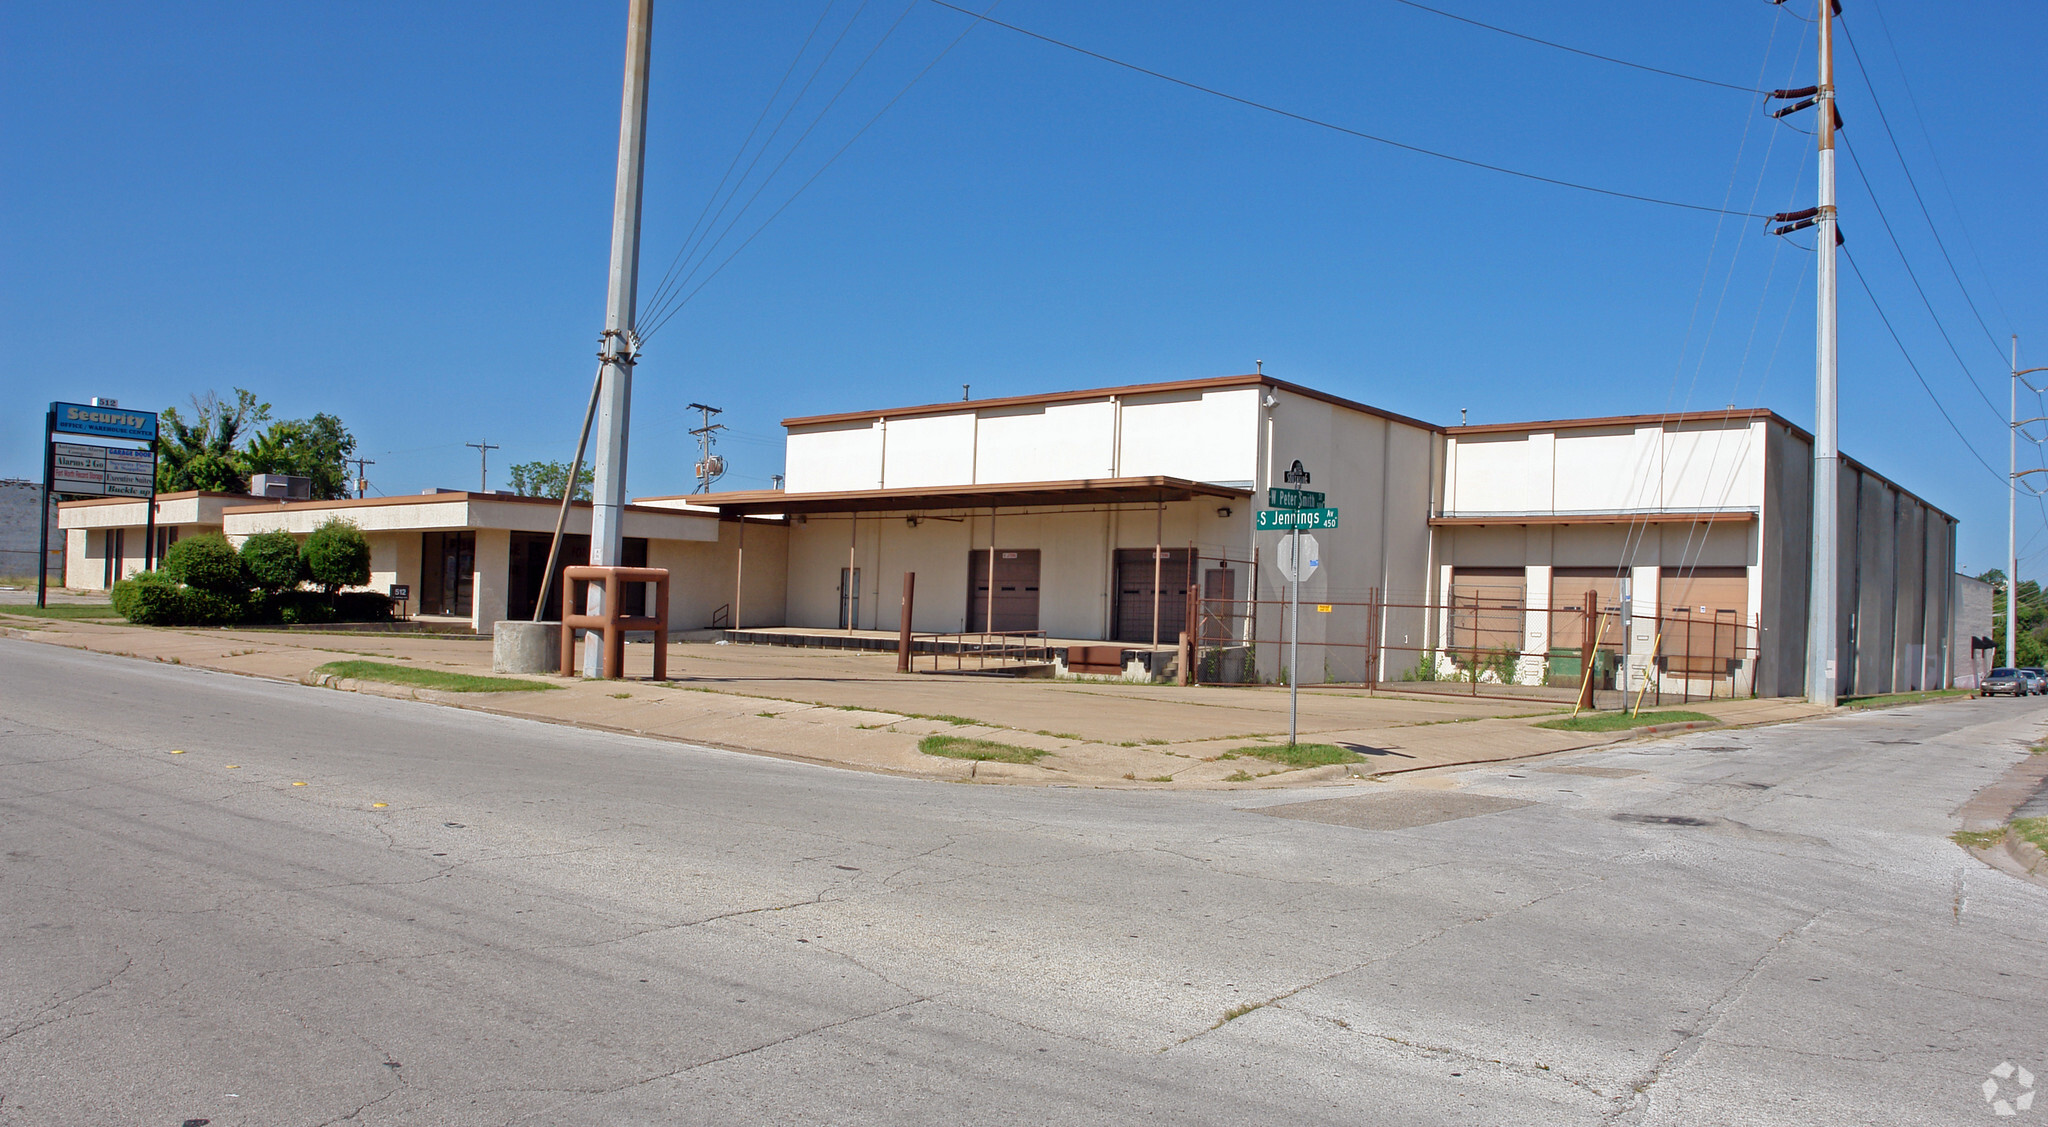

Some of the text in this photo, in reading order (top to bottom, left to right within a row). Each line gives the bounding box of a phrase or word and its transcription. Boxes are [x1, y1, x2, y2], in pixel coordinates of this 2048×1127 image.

[99, 399, 116, 407] 512
[67, 407, 146, 429] Security
[88, 424, 128, 434] WAREHOUSE
[108, 448, 133, 456] GARAGE
[58, 456, 104, 468] Alarms 2 Go
[106, 473, 152, 484] Executive Suites
[108, 485, 151, 496] Buckle up
[1271, 490, 1315, 508] W Peter Smith
[1327, 509, 1334, 517] Av
[1260, 510, 1320, 528] S Jennings
[1323, 519, 1336, 528] 450
[394, 588, 407, 596] 512
